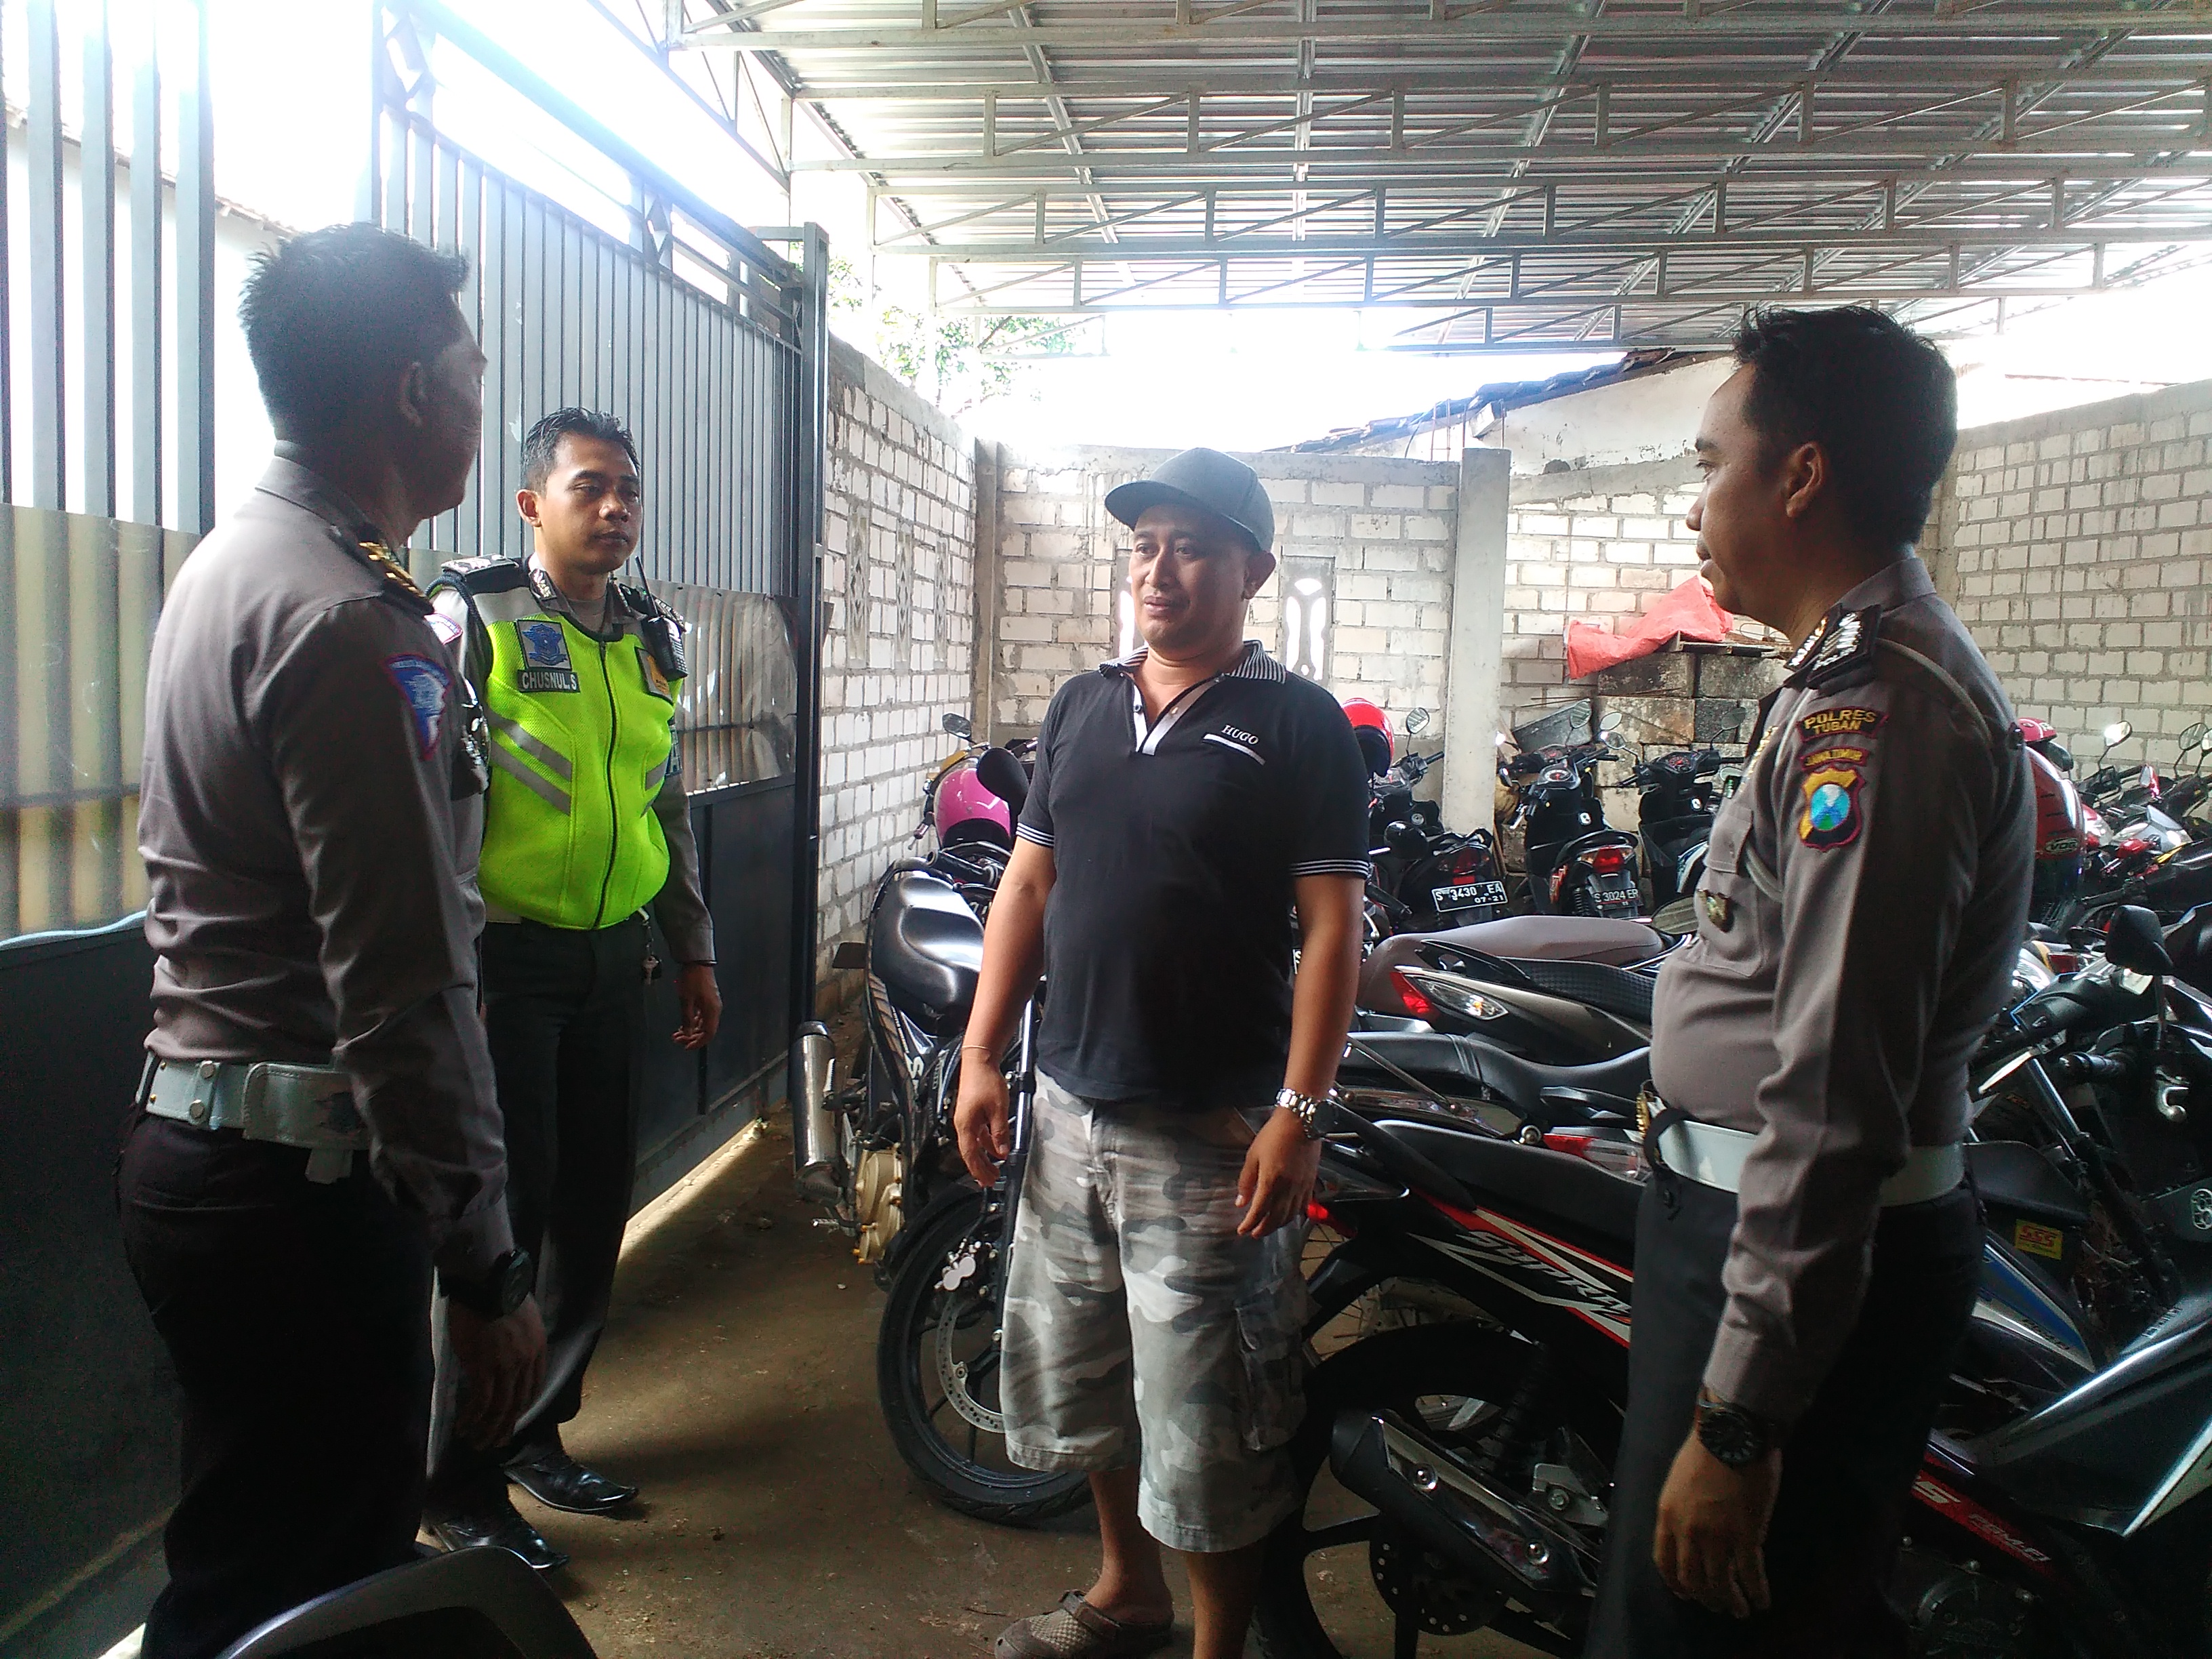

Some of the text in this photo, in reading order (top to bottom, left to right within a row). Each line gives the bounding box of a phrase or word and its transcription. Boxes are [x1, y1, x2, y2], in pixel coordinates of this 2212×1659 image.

[1803, 709, 1877, 729] POLRES
[1811, 720, 1862, 735] TUBAN
[1221, 724, 1258, 745] HUGO
[1435, 882, 1502, 901] S 3430 EA
[1594, 893, 1602, 903] S
[1602, 890, 1626, 901] 3024
